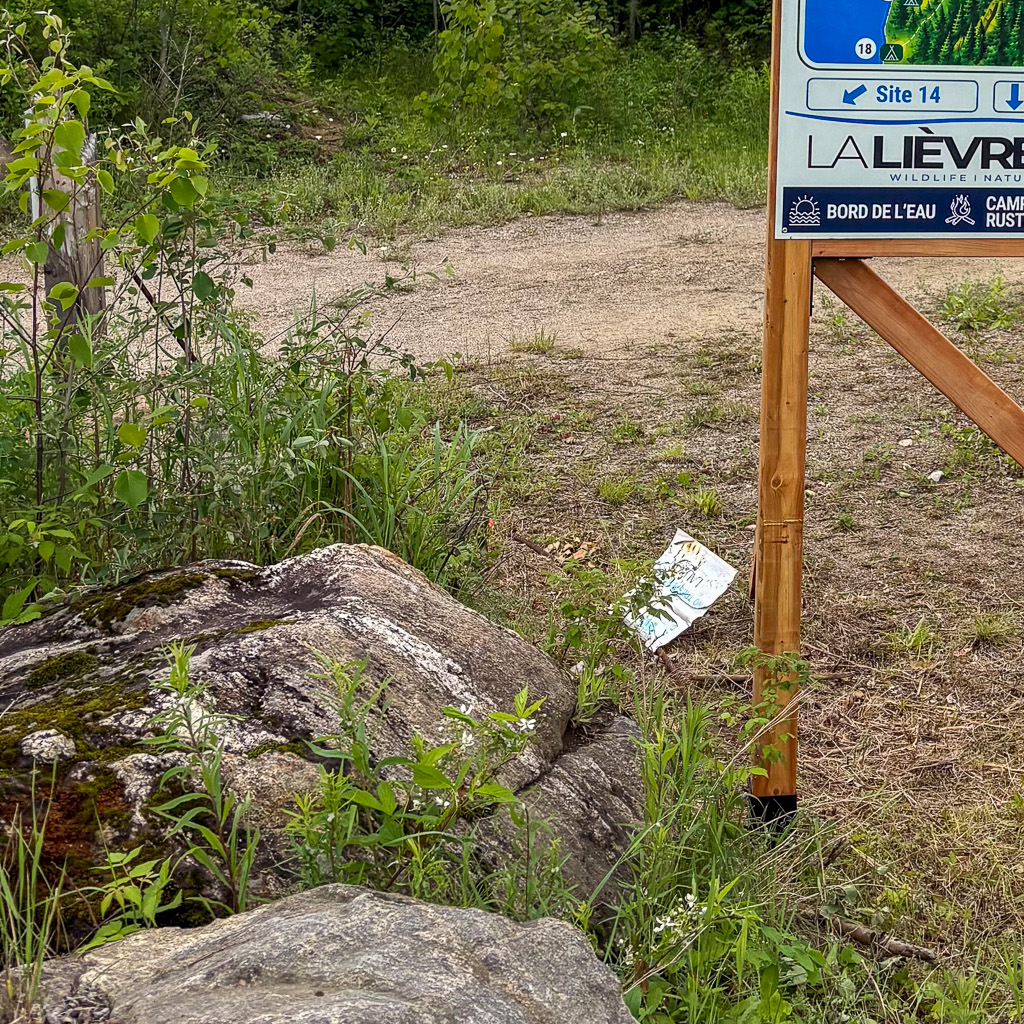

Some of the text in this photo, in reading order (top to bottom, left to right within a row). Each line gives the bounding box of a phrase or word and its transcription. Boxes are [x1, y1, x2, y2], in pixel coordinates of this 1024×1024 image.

[876, 85, 940, 104] Site 14
[808, 134, 868, 168] LA
[890, 174, 967, 182] WILDLIFE
[826, 204, 936, 219] BORD DE L'EAU
